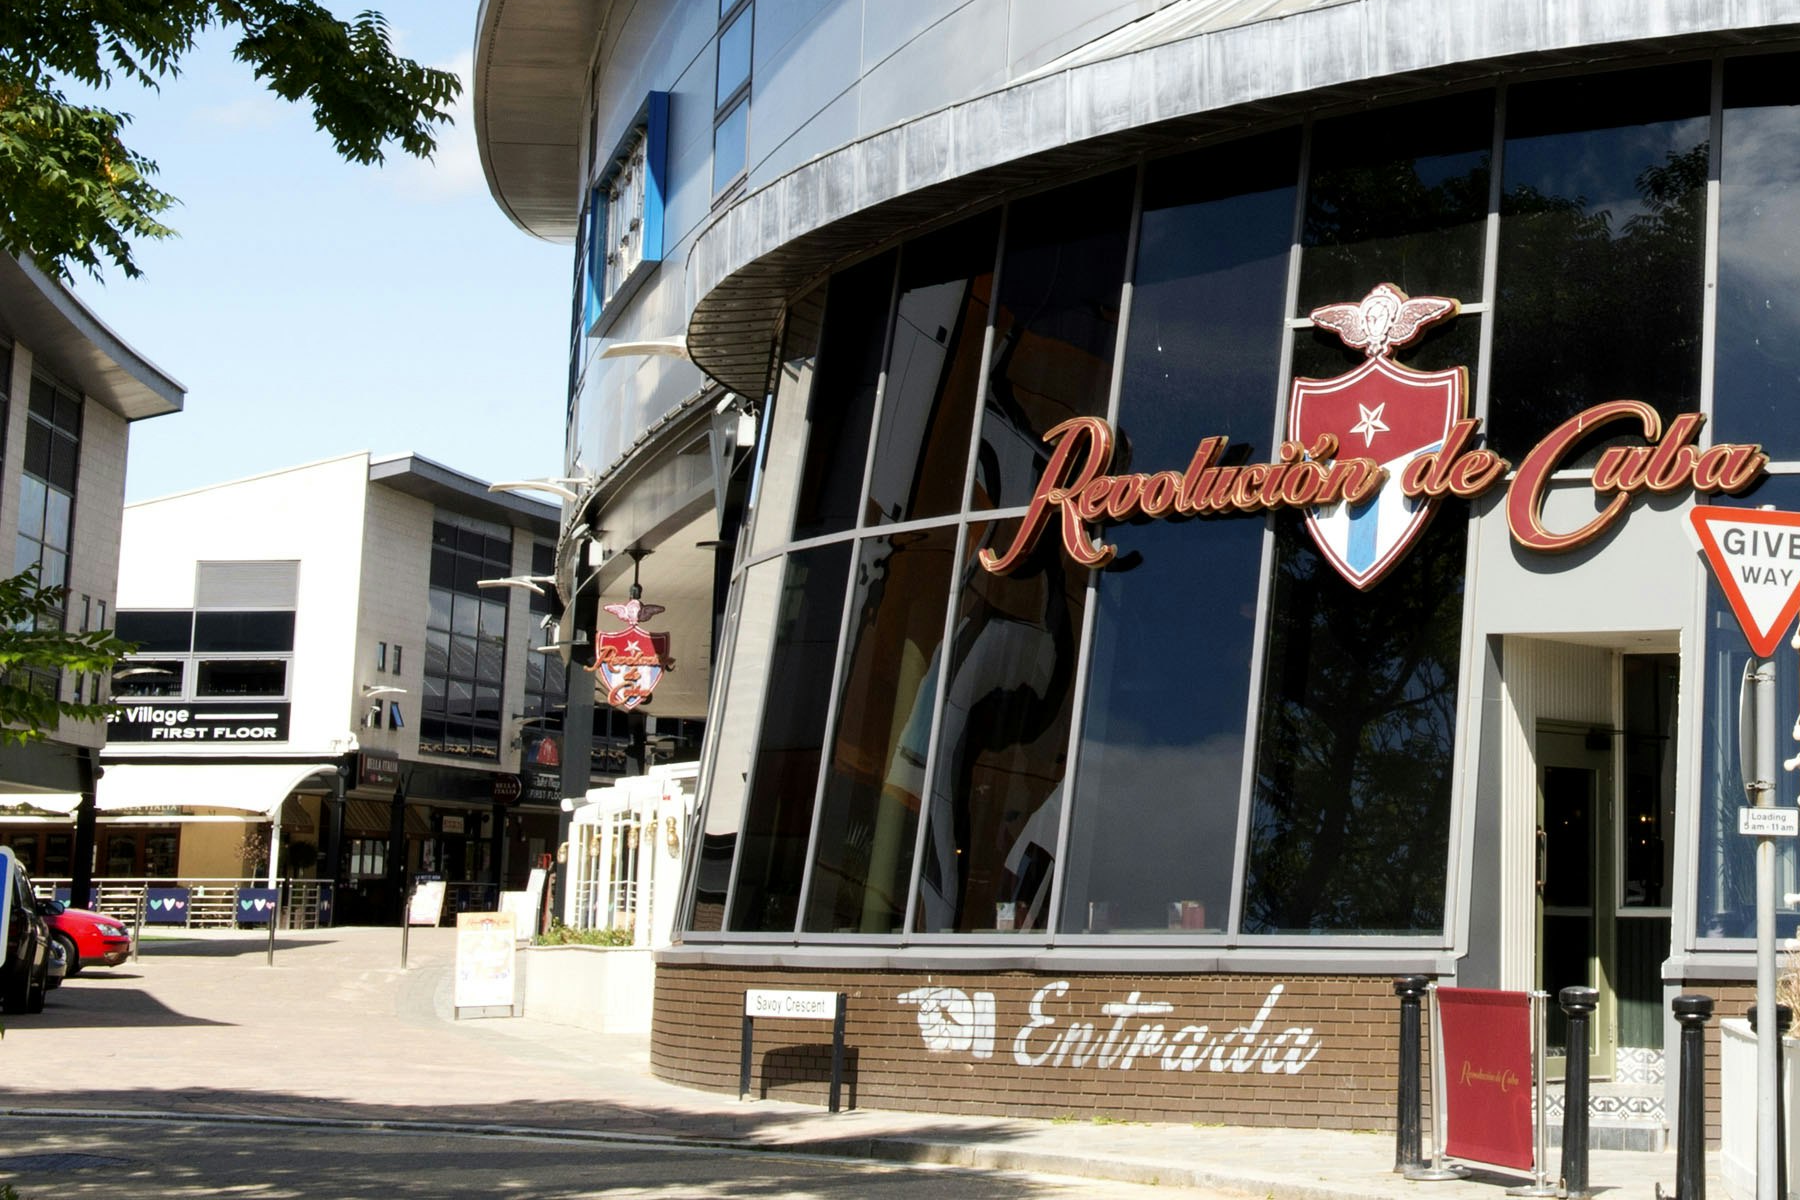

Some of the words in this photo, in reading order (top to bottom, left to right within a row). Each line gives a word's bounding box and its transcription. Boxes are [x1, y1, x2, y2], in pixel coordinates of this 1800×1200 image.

[979, 415, 1388, 575] Revolución
[1401, 418, 1511, 500] de
[1506, 399, 1772, 555] Cuba
[1742, 566, 1794, 586] WAY
[125, 706, 190, 726] Village
[151, 727, 208, 739] FIRST
[213, 727, 277, 739] FLOOR
[1751, 813, 1787, 822] Loading
[756, 995, 782, 1013] Savoy
[785, 996, 825, 1013] Crescent
[1013, 980, 1322, 1075] Entrada
